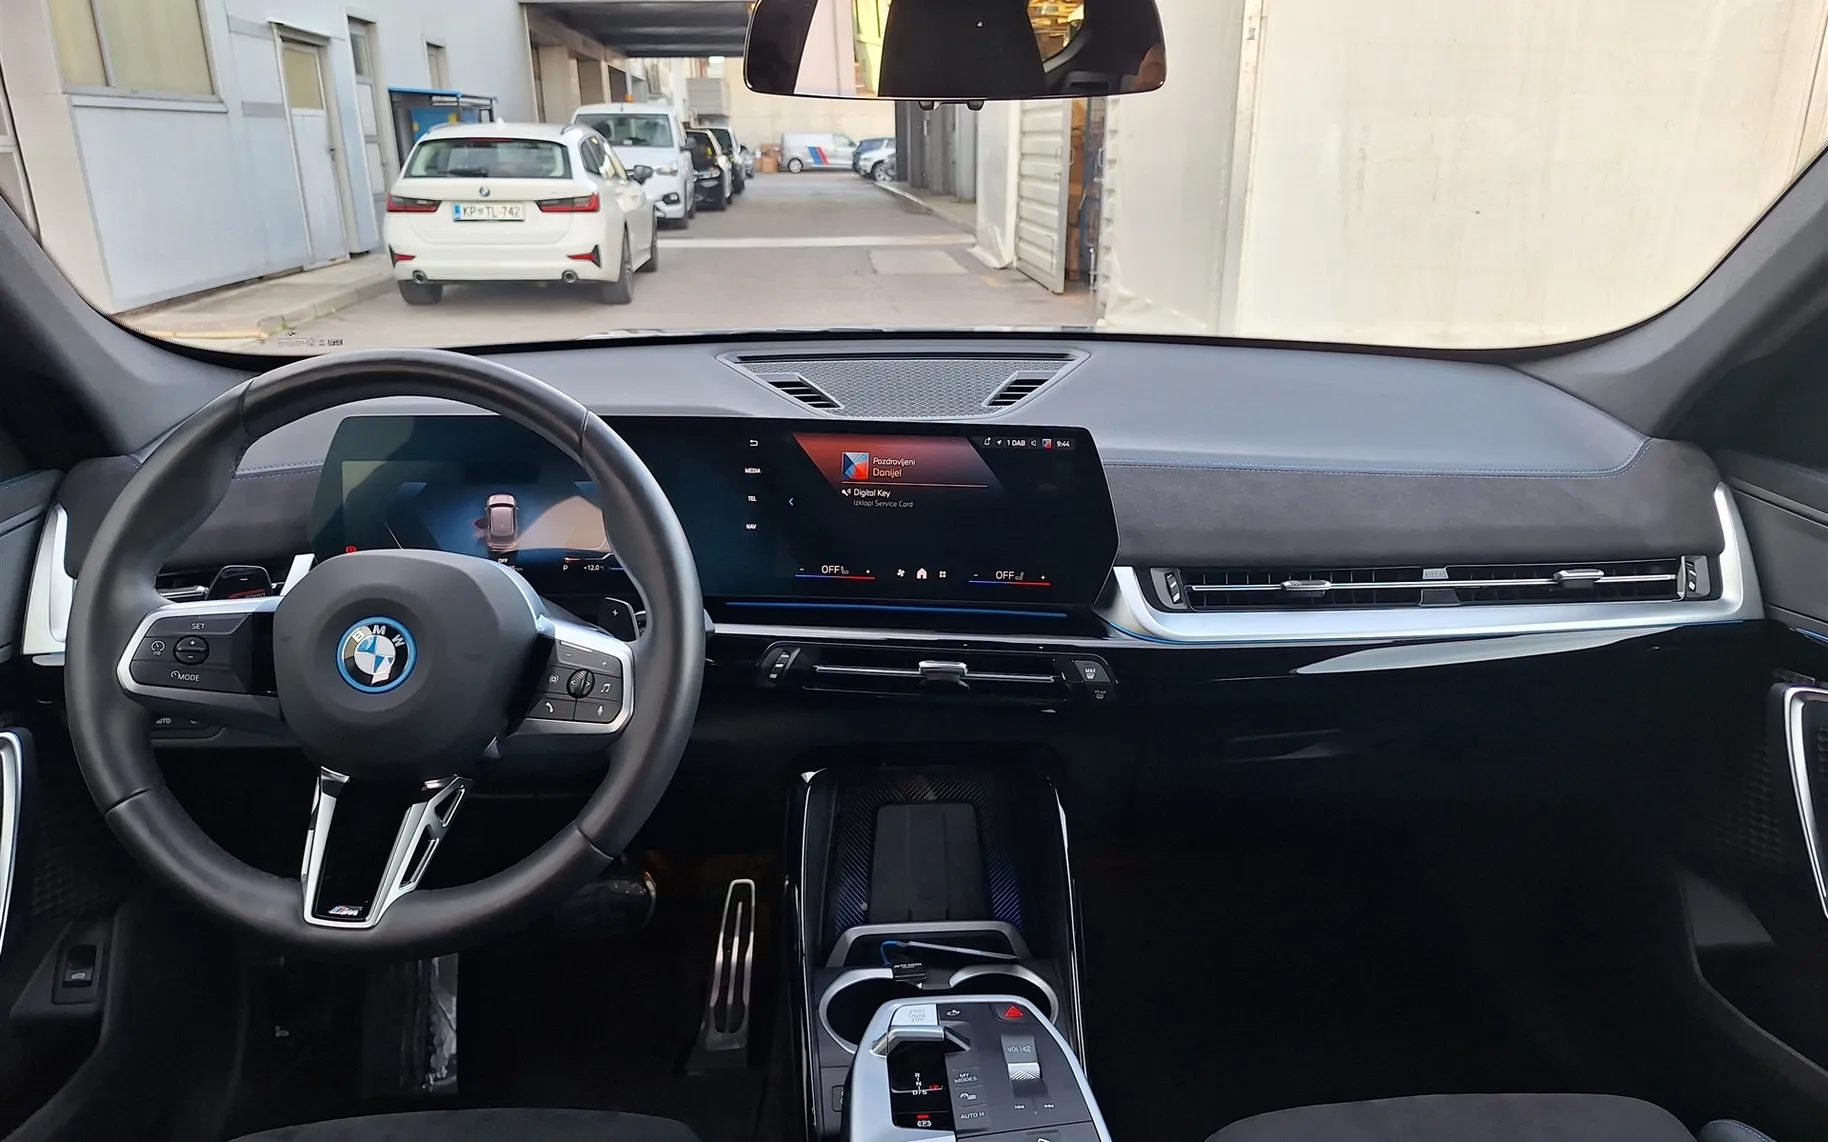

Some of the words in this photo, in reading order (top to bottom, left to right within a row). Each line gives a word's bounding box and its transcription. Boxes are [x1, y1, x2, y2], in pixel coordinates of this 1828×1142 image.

[463, 205, 477, 216] KP
[1056, 440, 1070, 448] 9:44
[872, 457, 916, 467] Pozdravljeni
[872, 468, 902, 478] Danijel
[853, 488, 876, 498] Digital
[877, 489, 891, 498] Key
[874, 500, 898, 508] Service
[821, 564, 840, 574] OFF
[995, 570, 1015, 580] OFF
[191, 622, 205, 630] SET
[351, 624, 405, 648] BMW
[178, 673, 200, 682] MODE
[1007, 1045, 1019, 1053] VOL
[954, 1076, 978, 1084] MODES
[960, 1112, 979, 1120] AUTO
